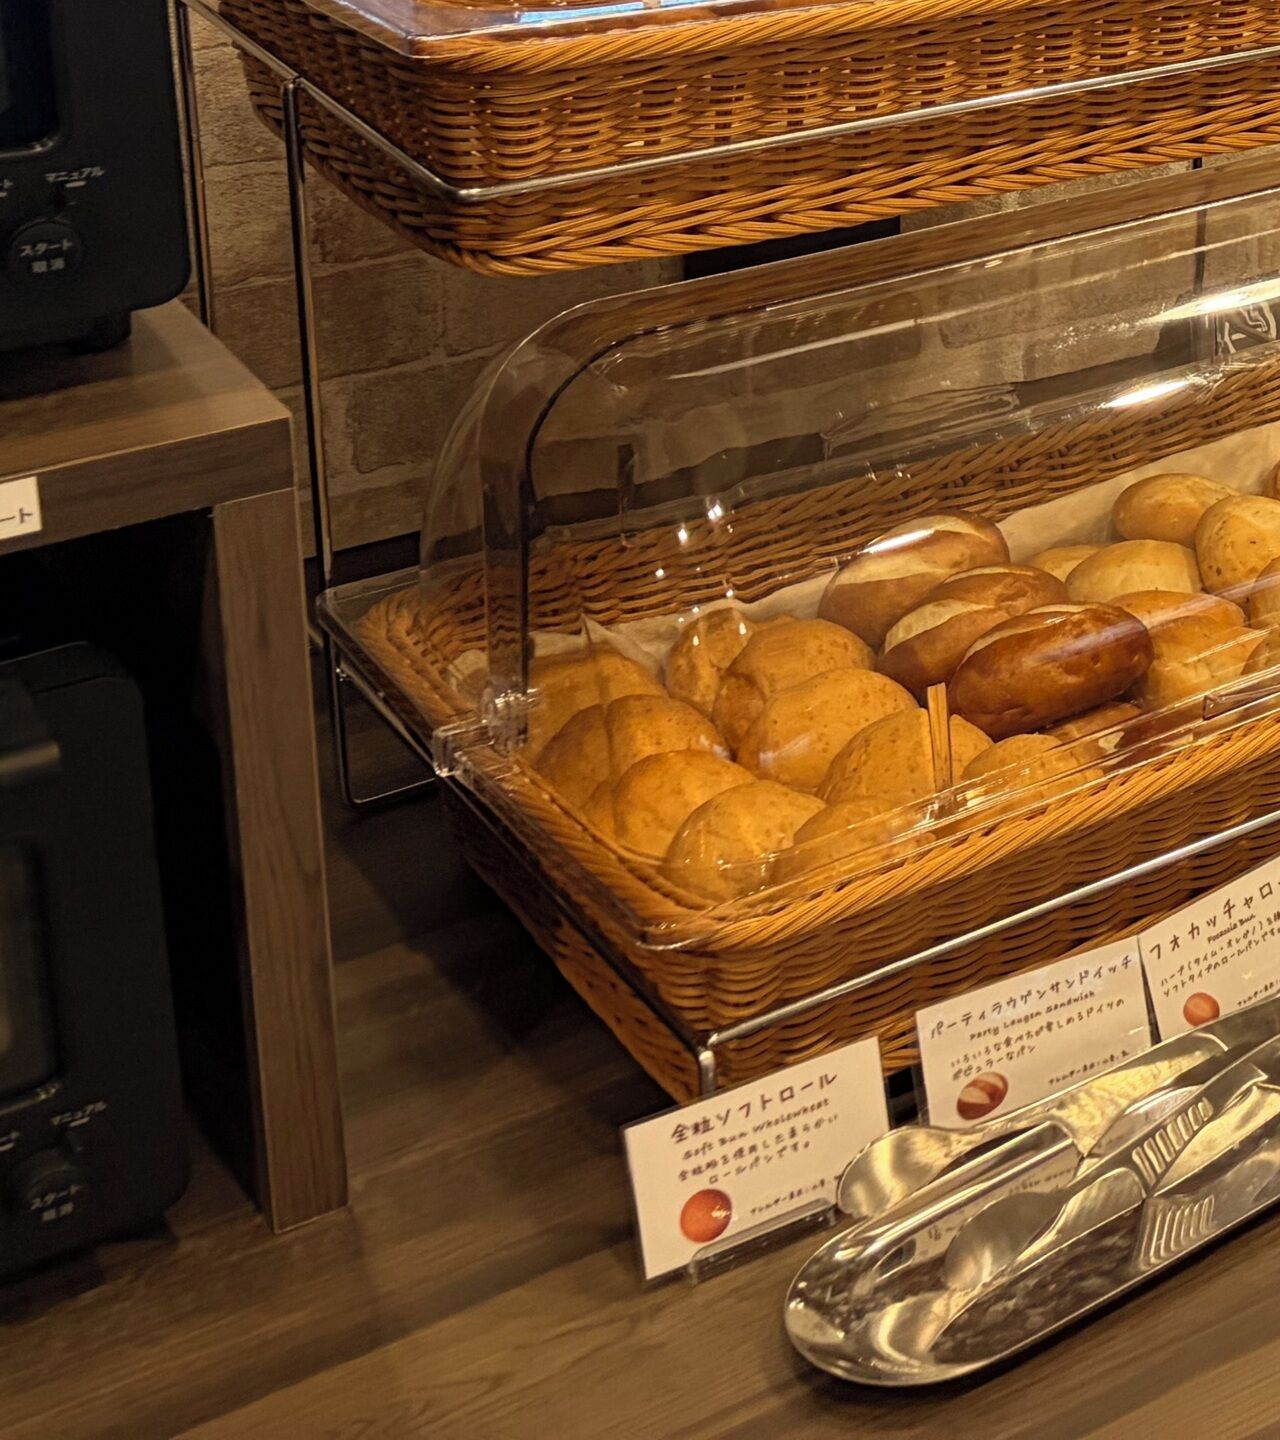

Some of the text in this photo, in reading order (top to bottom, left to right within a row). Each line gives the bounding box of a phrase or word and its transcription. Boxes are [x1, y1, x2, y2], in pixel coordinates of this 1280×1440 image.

[45, 166, 105, 183] マニュアル
[20, 238, 73, 257] スタート
[1239, 913, 1257, 926] Bun
[969, 990, 1096, 1042] Party Laugen Sandwich
[671, 1073, 838, 1145] 全粒ソフトロール
[682, 1098, 831, 1161] Soft Bun Wholewheat
[709, 1140, 811, 1185] ロールパンです。
